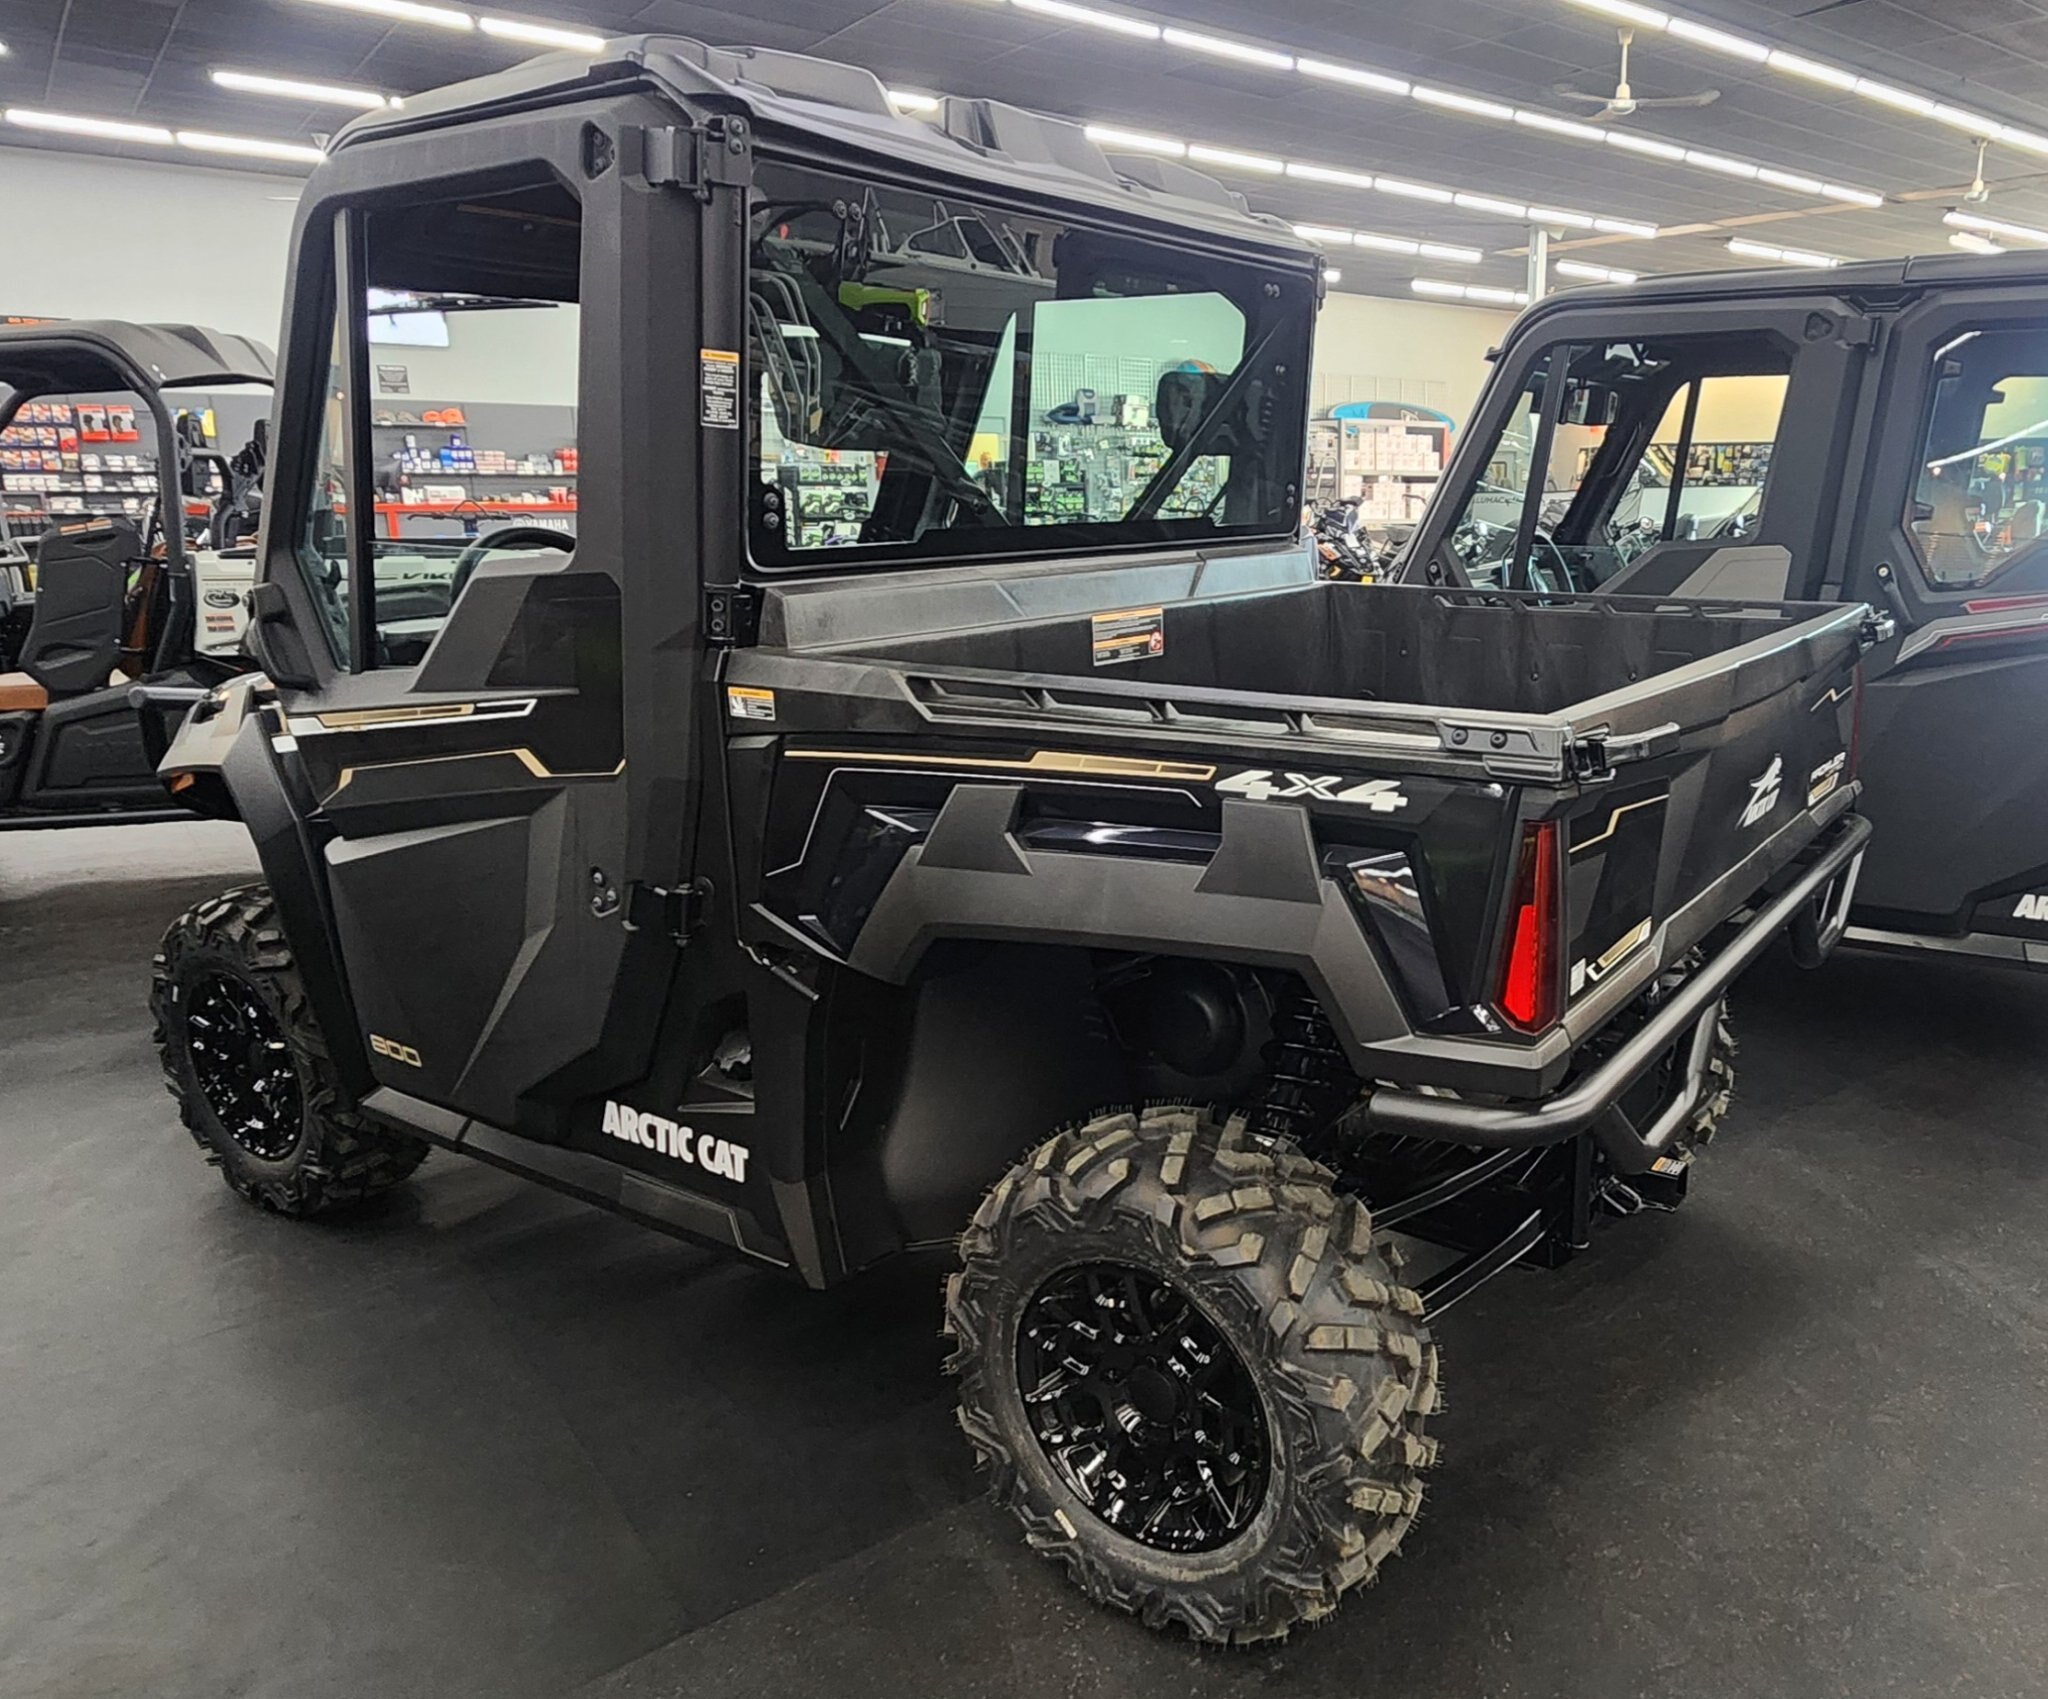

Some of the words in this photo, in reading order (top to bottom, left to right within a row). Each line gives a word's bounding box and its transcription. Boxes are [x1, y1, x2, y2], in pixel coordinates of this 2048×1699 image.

[525, 518, 570, 531] YAMAHA
[402, 572, 454, 580] VIKI
[369, 1033, 423, 1068] 800
[602, 1100, 695, 1164] ARCTIC
[697, 1134, 749, 1184] CAT
